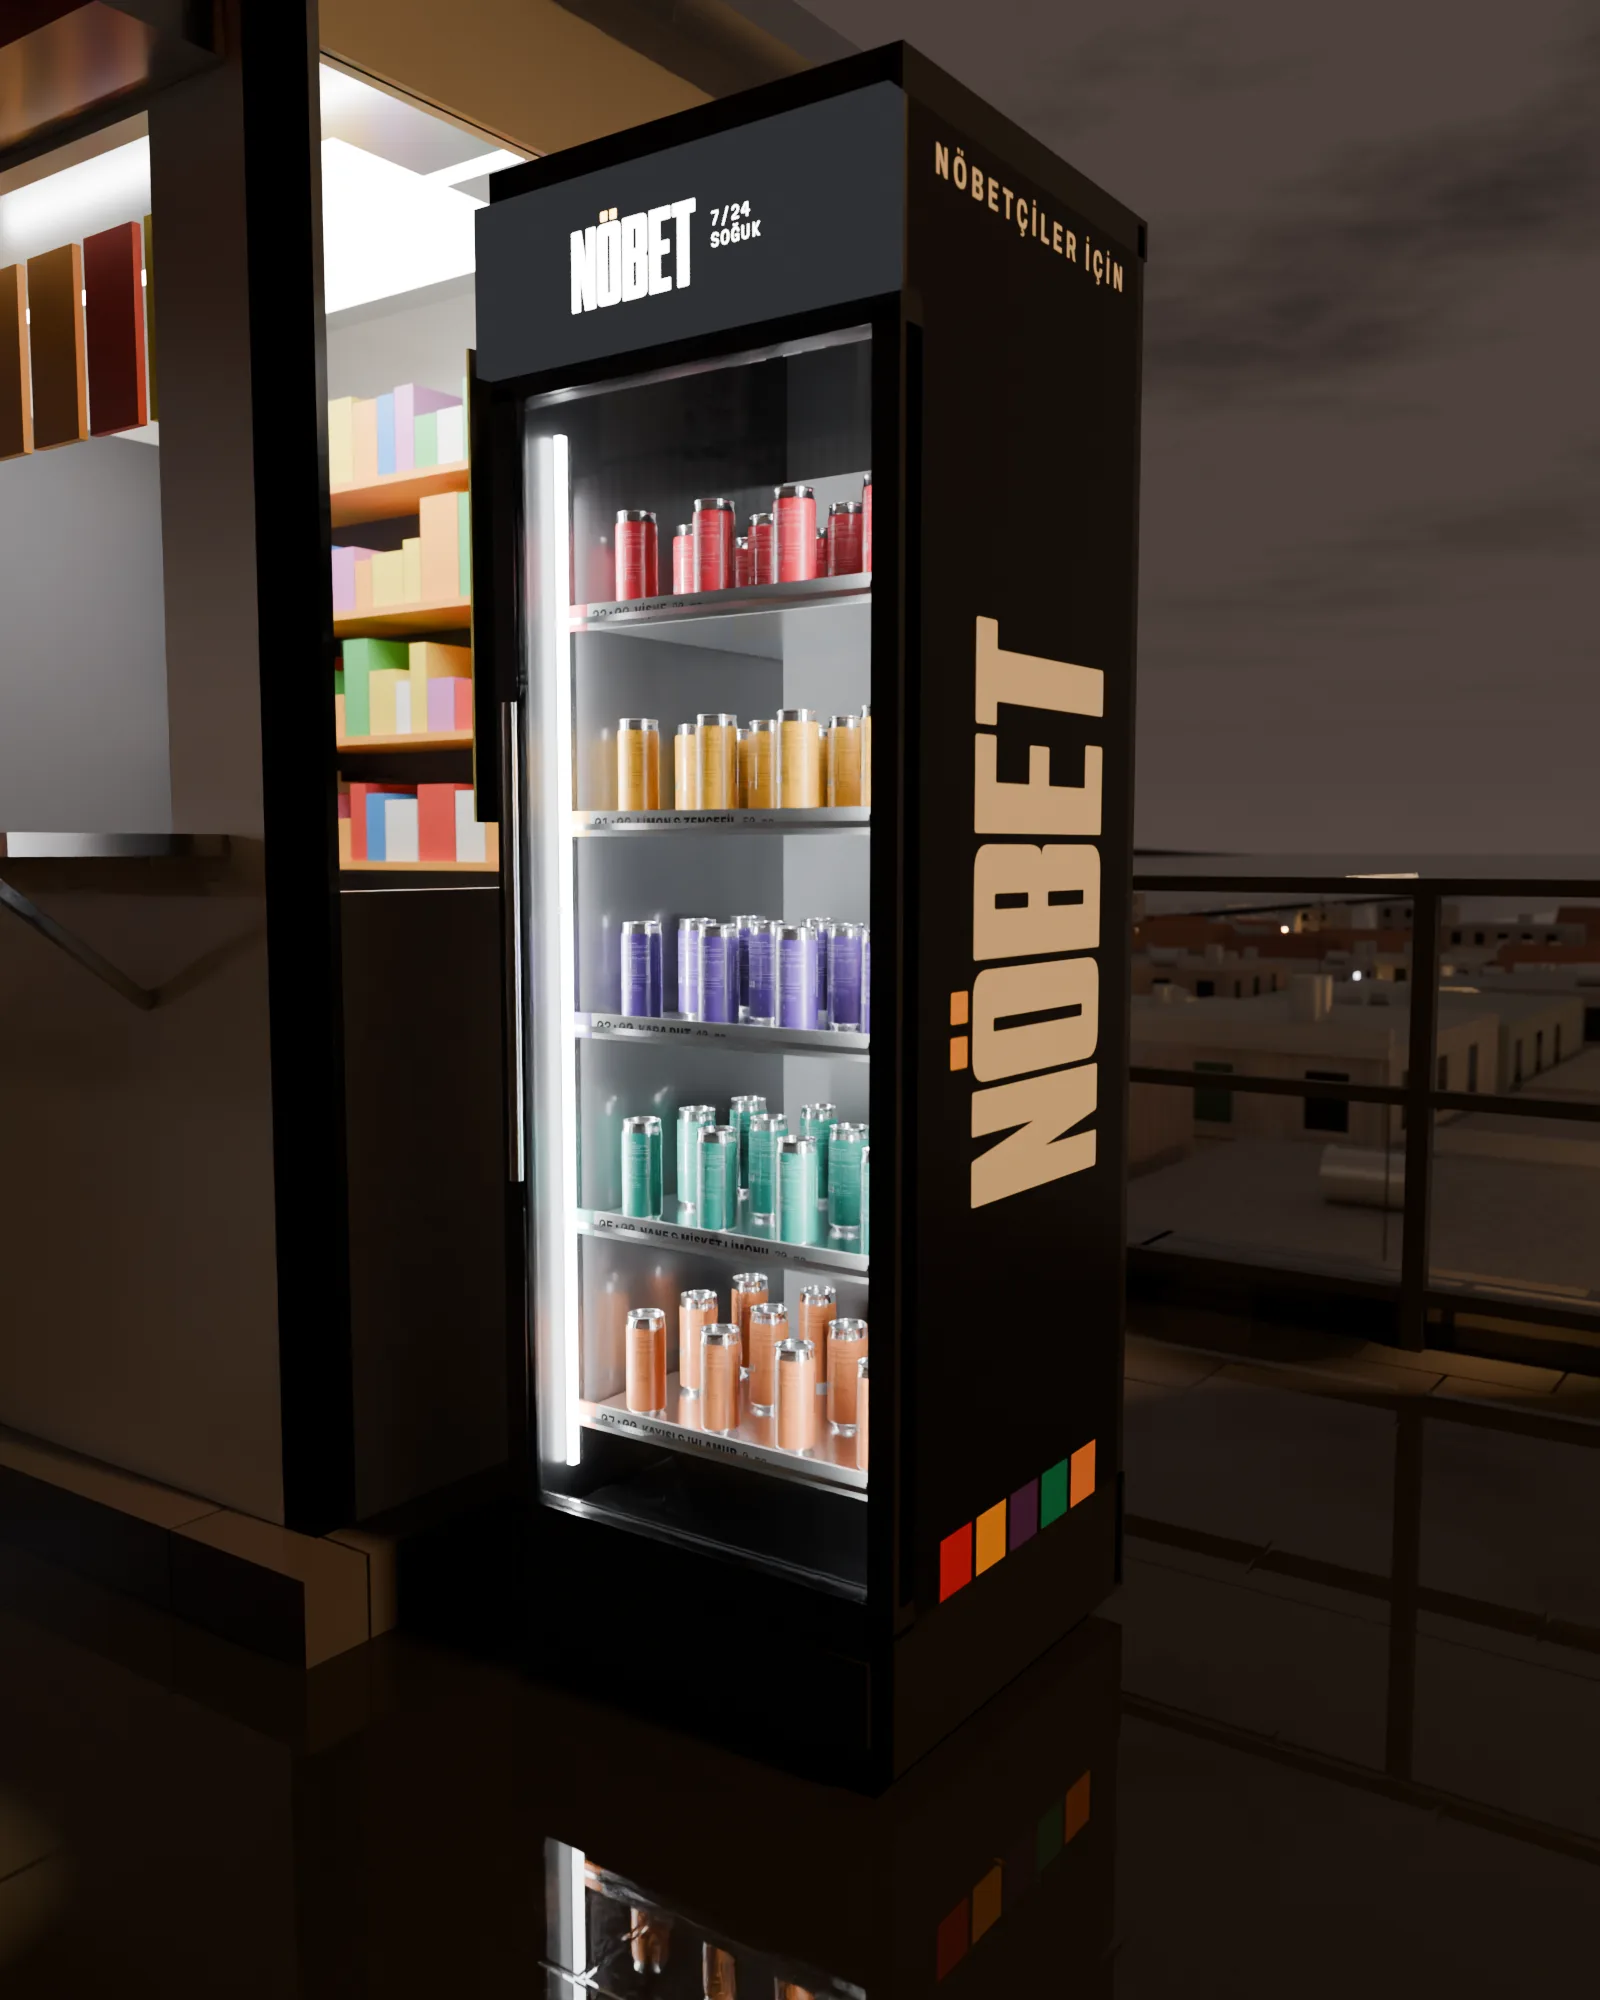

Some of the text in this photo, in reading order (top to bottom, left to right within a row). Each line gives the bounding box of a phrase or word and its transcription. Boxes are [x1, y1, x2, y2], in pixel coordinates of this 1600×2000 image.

[570, 196, 697, 315] NÖBET
[709, 200, 751, 227] 7/24
[709, 219, 762, 249] SOĞUK
[935, 141, 1123, 293] NÖBETÇİLER İÇİN
[950, 615, 1104, 1209] NÖBET
